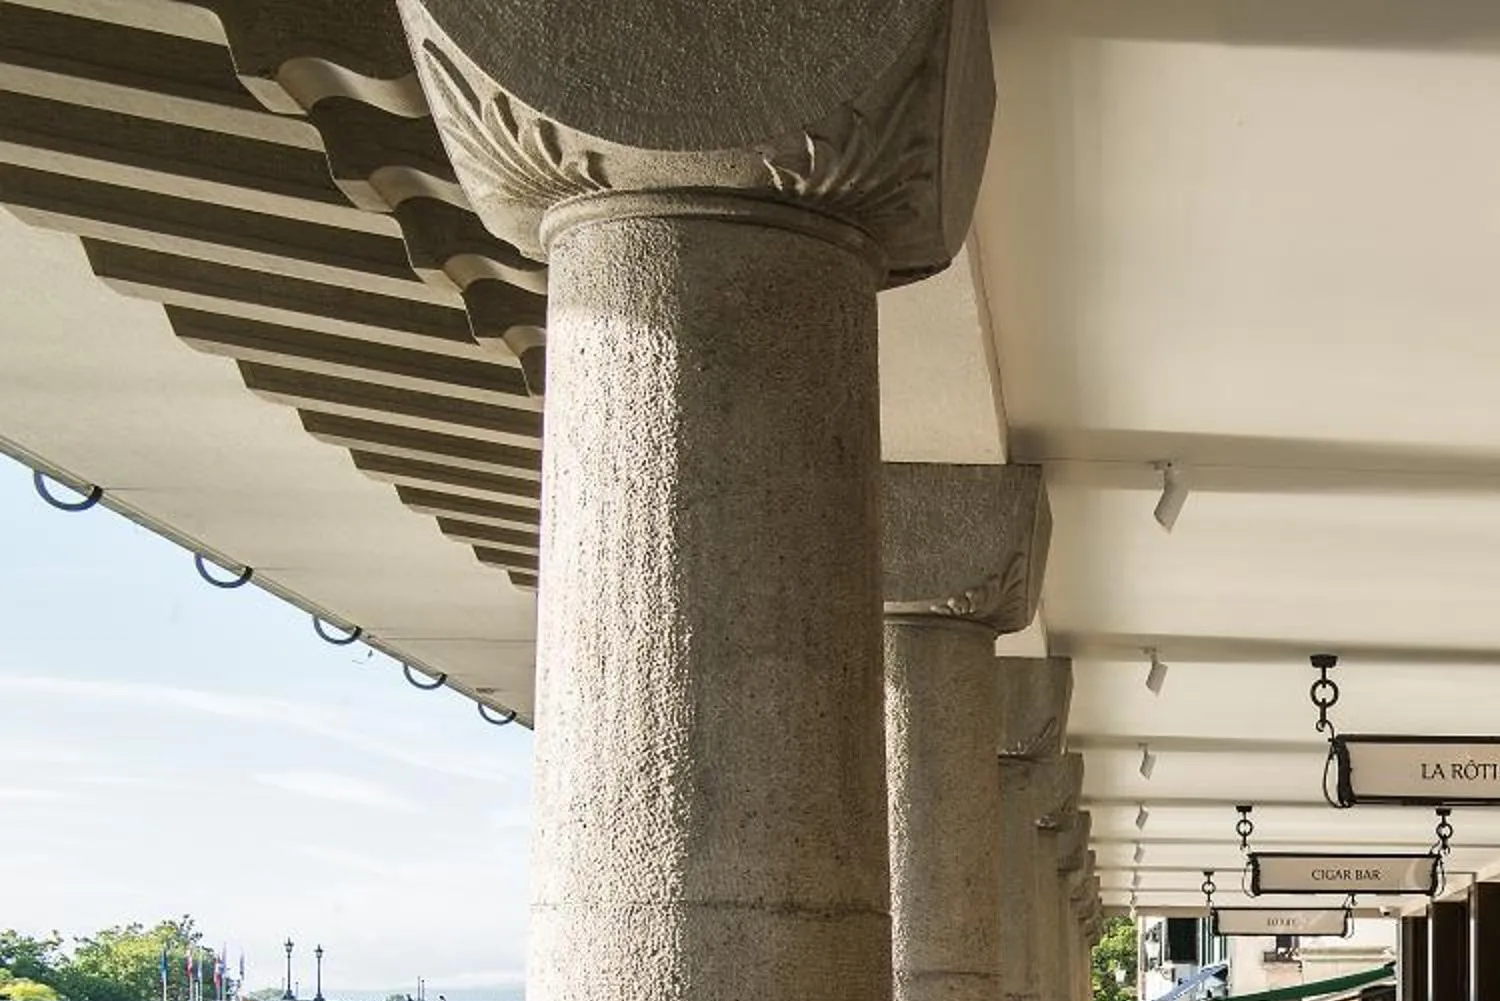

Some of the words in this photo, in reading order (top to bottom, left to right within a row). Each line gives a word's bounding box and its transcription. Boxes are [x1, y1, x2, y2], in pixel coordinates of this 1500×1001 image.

[1421, 762, 1445, 780] LA
[1311, 869, 1353, 881] CIGAR
[1355, 869, 1381, 881] BAR
